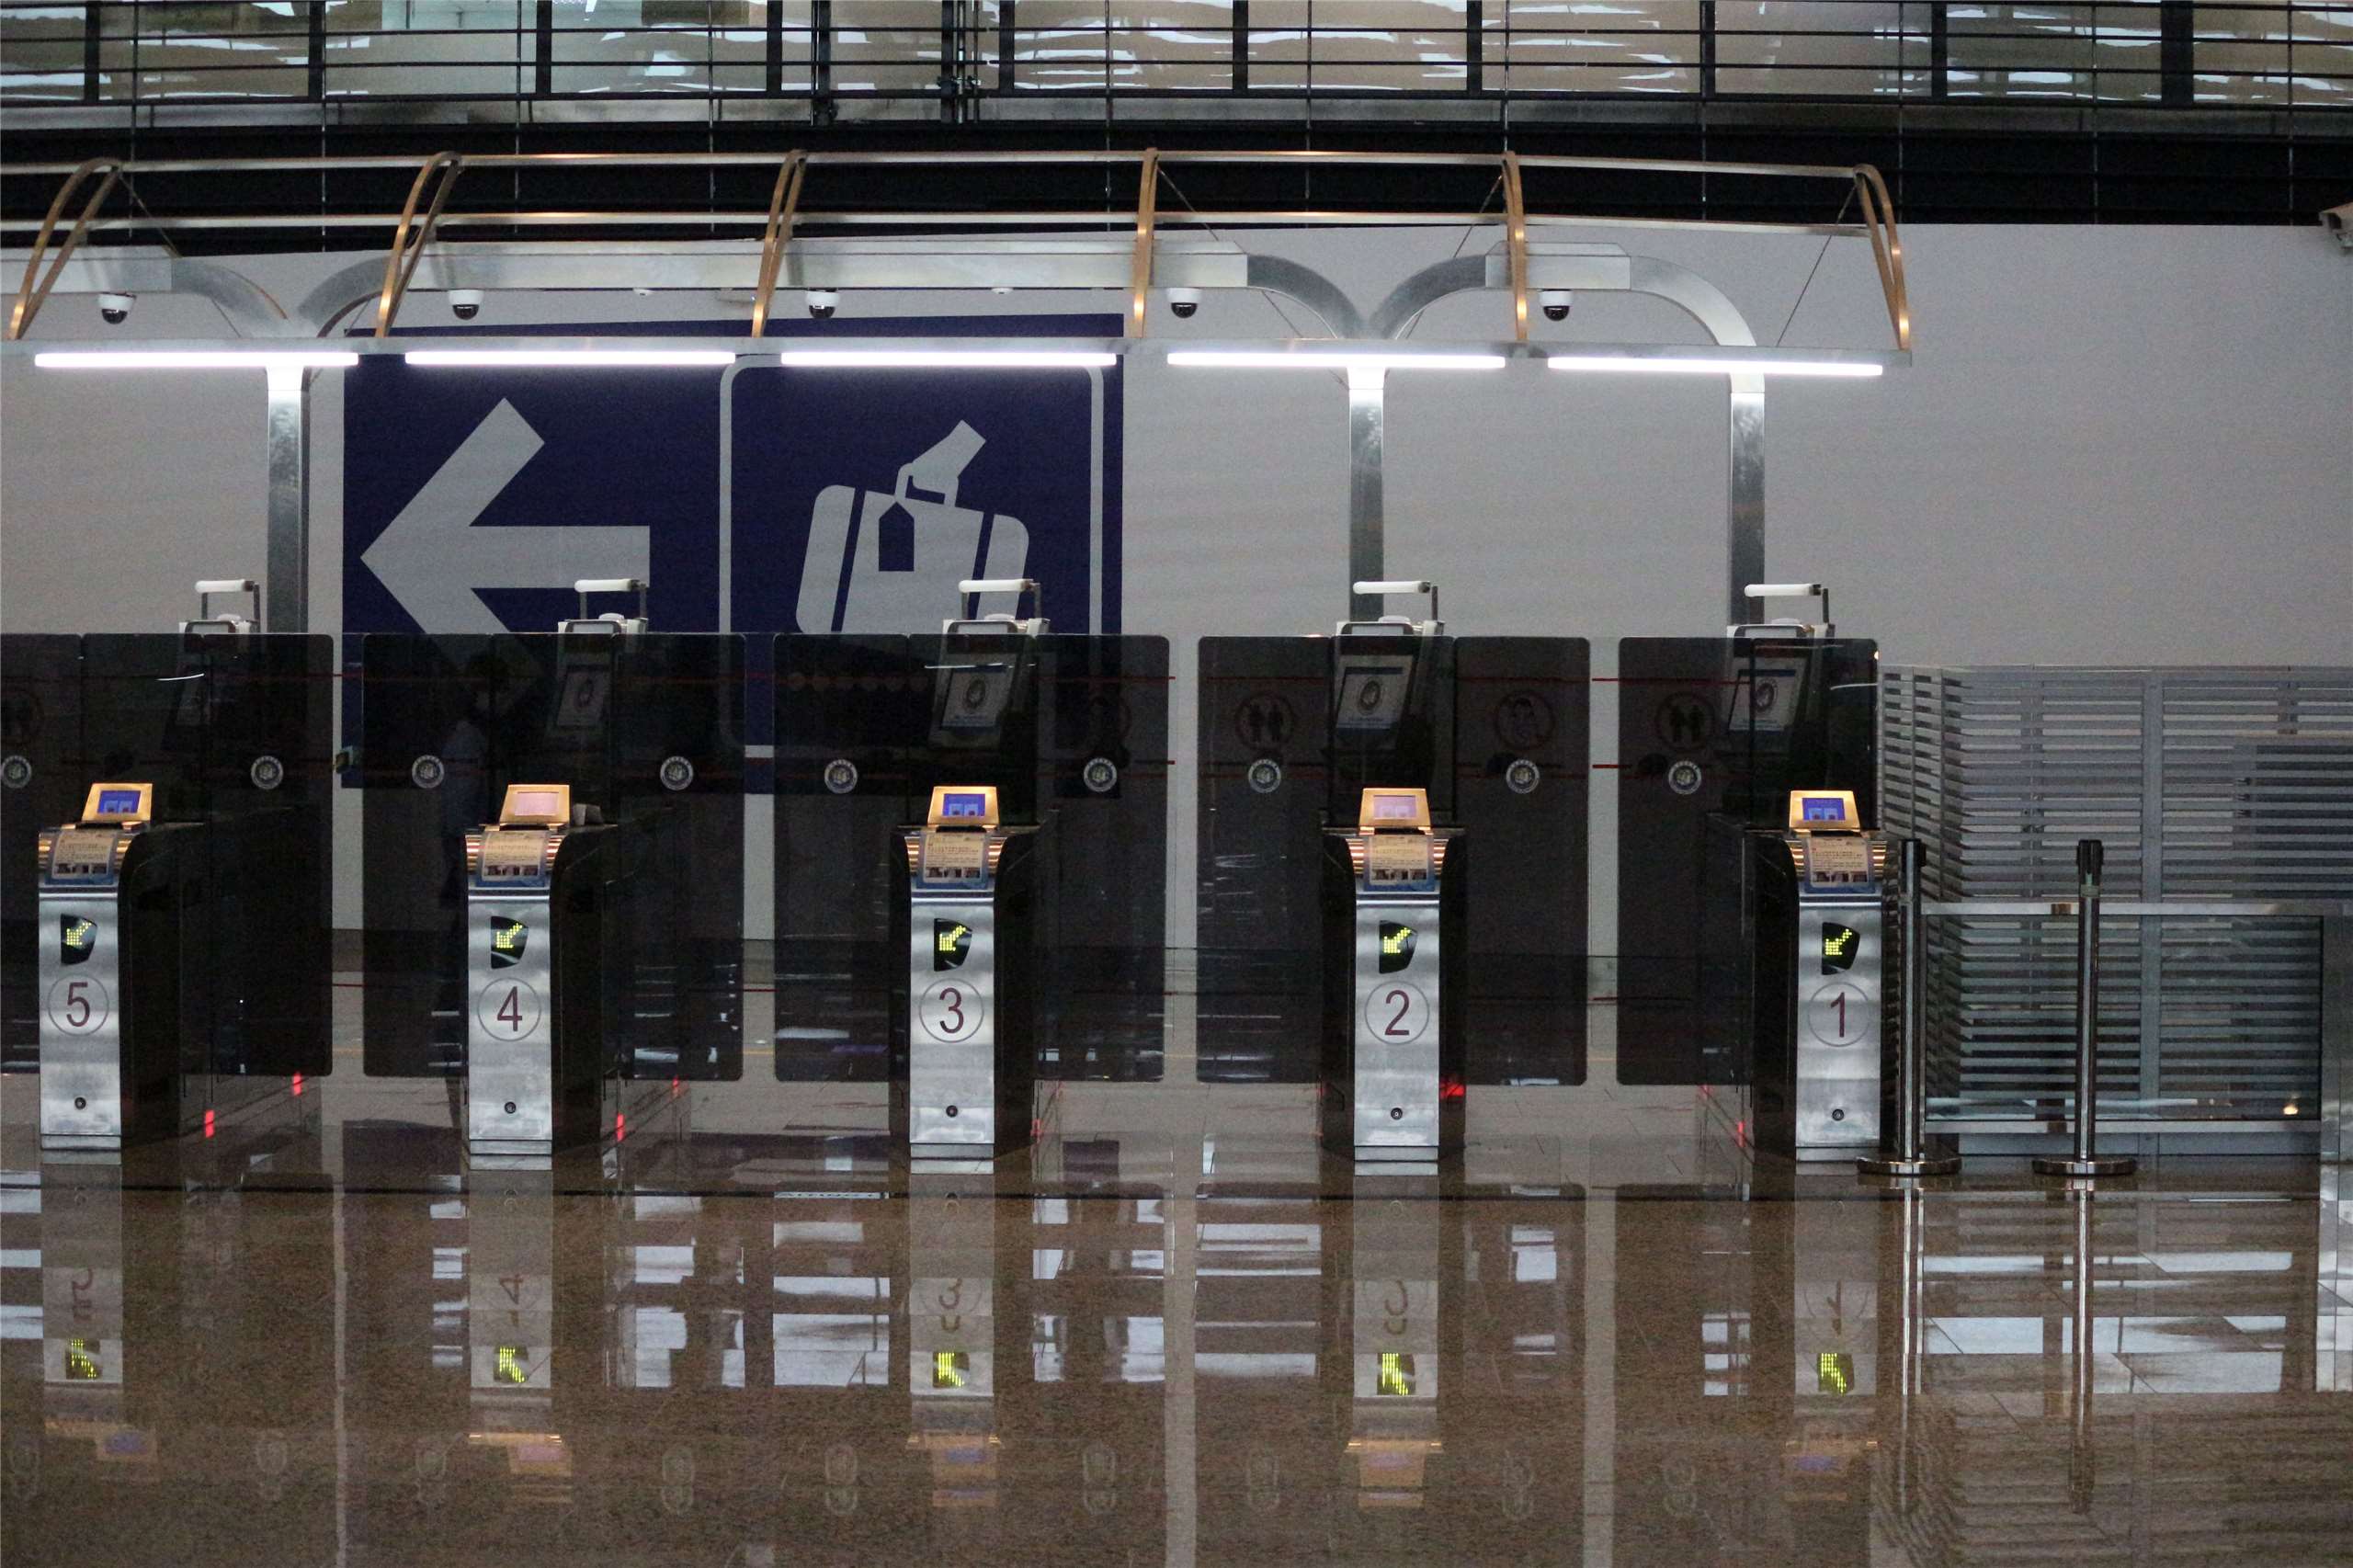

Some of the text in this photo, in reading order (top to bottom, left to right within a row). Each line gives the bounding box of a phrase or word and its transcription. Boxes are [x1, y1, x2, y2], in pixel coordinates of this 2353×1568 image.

[66, 983, 90, 1027] 5
[497, 986, 523, 1031] 4
[938, 988, 963, 1033] 3
[1385, 990, 1410, 1036] 2
[1830, 992, 1846, 1038] 1
